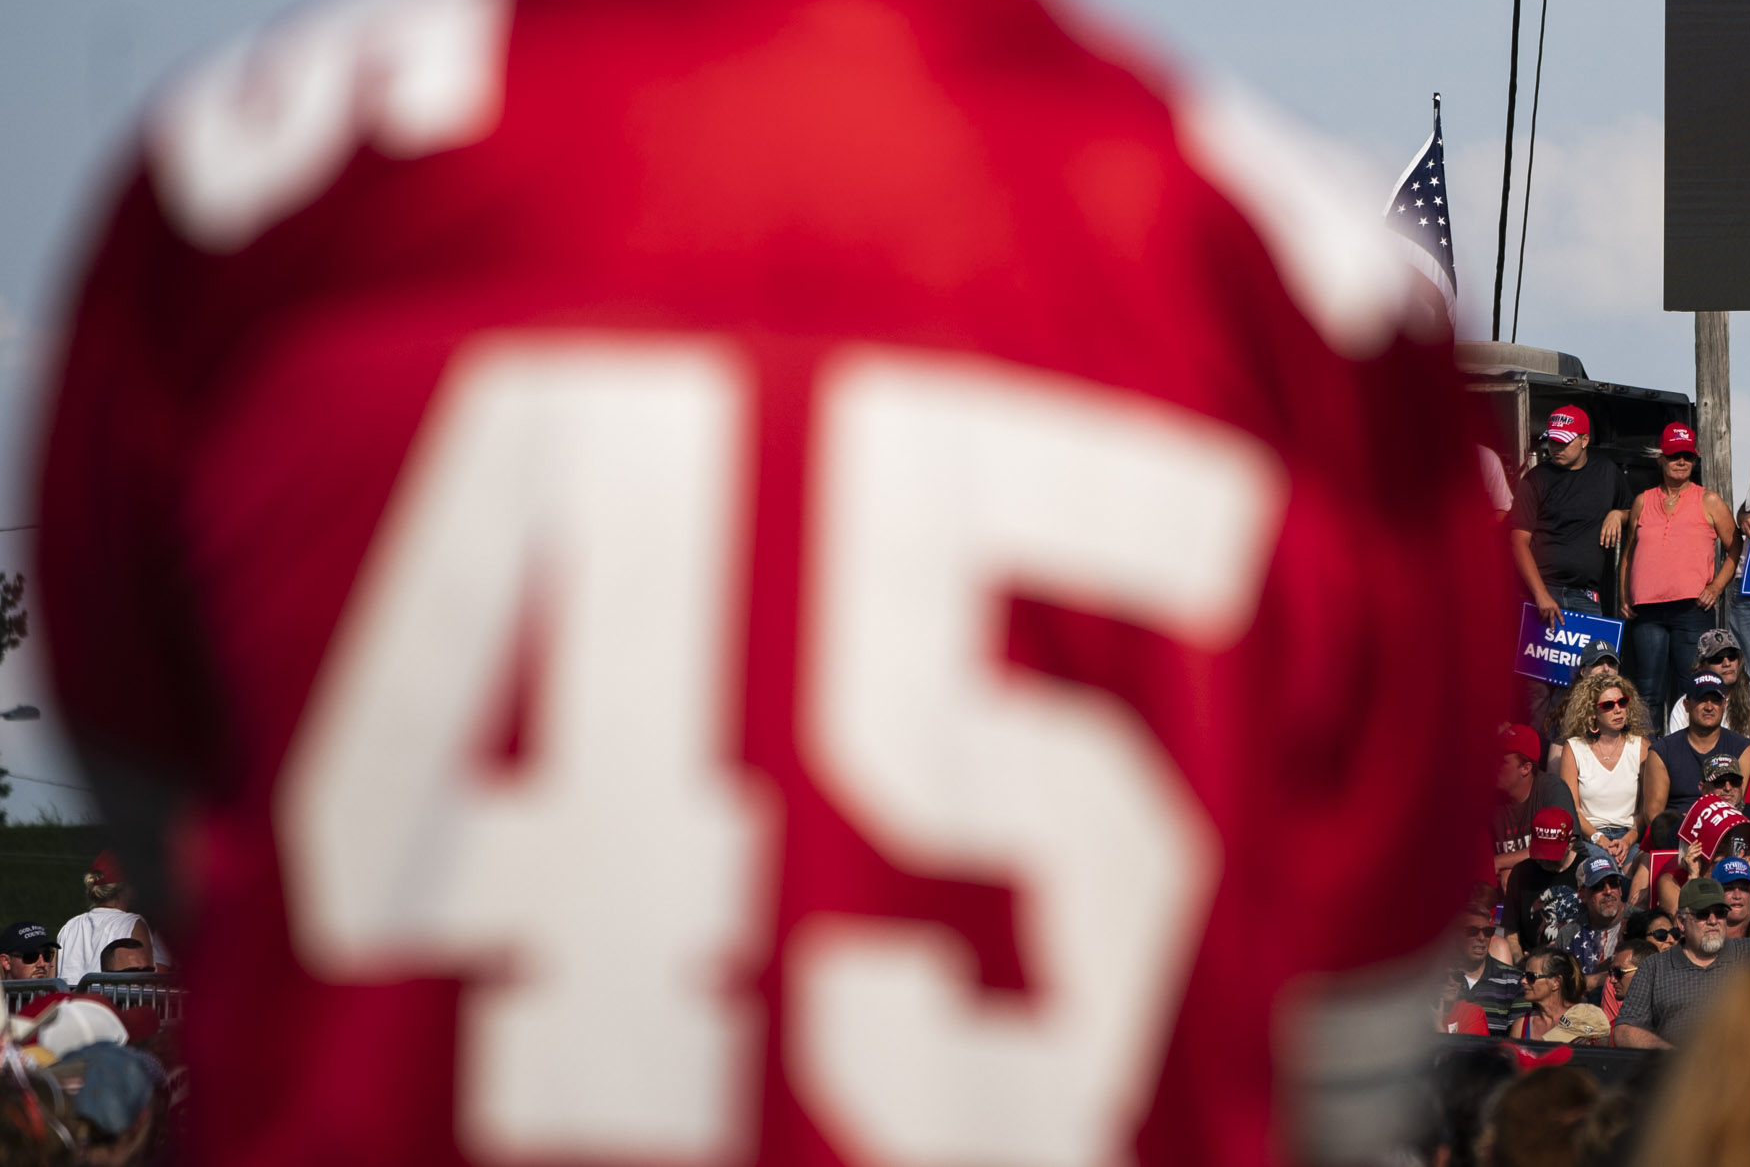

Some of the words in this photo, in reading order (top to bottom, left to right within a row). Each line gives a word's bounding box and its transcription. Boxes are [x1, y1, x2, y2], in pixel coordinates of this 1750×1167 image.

[1545, 627, 1591, 648] SAVE
[1694, 674, 1722, 685] TRUMP
[275, 327, 1290, 1167] 45
[1535, 827, 1562, 835] TRUMP
